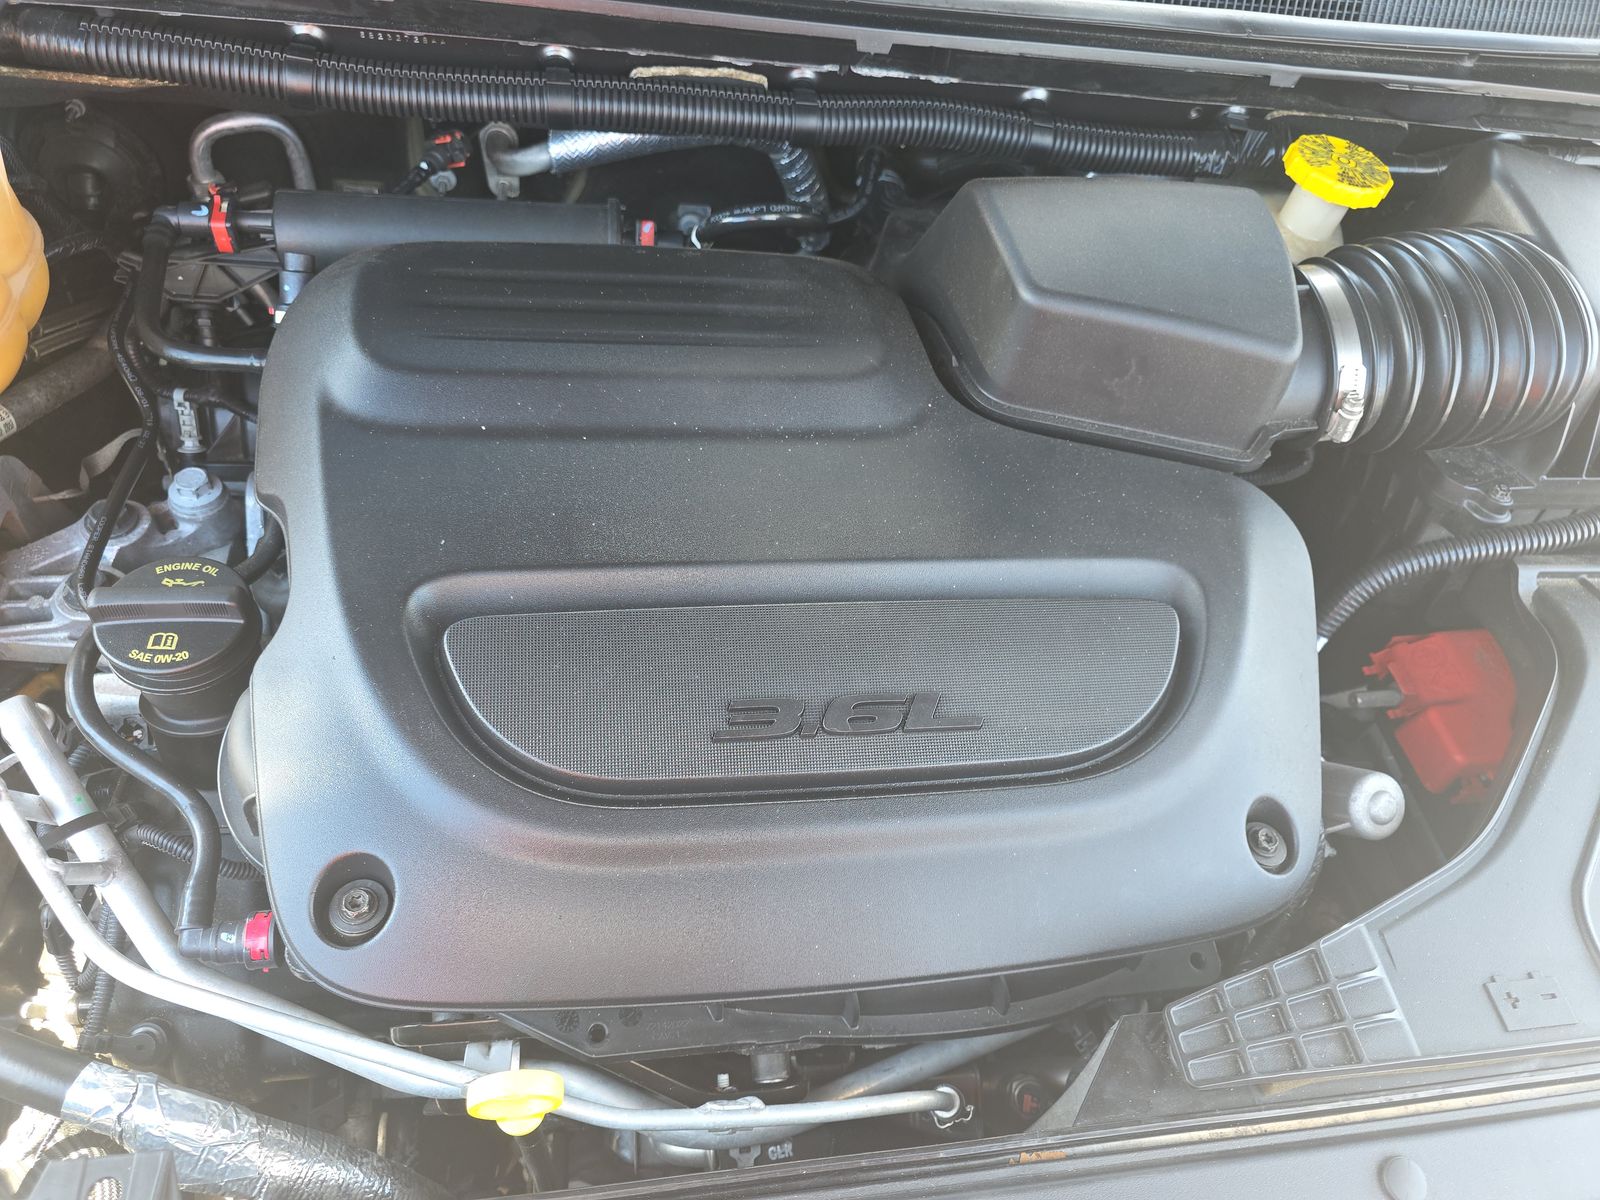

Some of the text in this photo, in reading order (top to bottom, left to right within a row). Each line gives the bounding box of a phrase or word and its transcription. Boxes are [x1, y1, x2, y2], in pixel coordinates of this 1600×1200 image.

[155, 562, 219, 577] ENGINE OIL
[128, 649, 190, 664] SAE 0W-20
[712, 690, 985, 743] 3.6L
